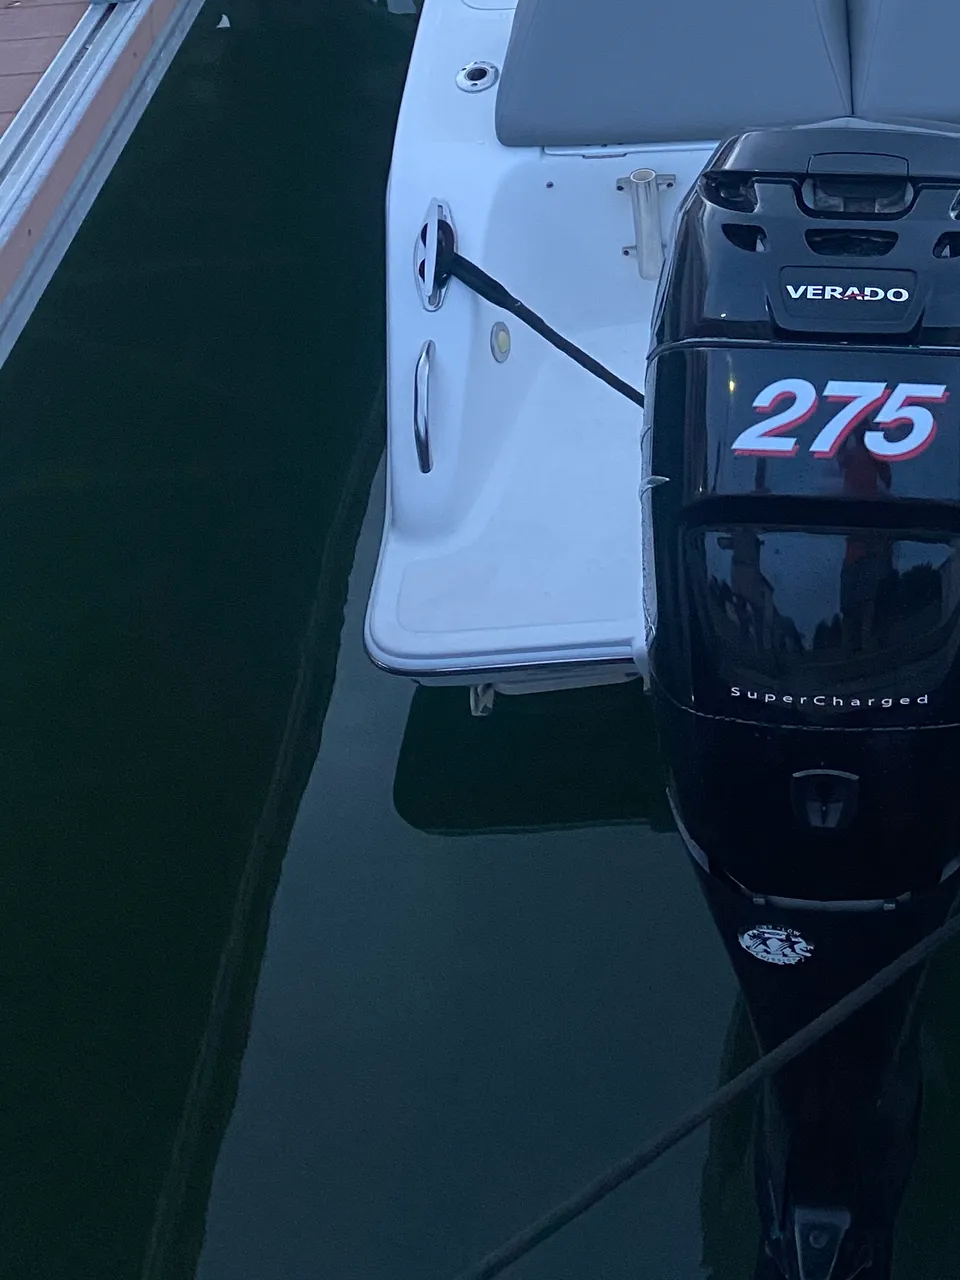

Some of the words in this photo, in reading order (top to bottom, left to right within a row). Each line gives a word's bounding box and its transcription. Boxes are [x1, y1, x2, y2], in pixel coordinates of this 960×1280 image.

[785, 284, 910, 303] VERADO
[731, 378, 950, 462] 275
[730, 685, 929, 708] SuperCharged
